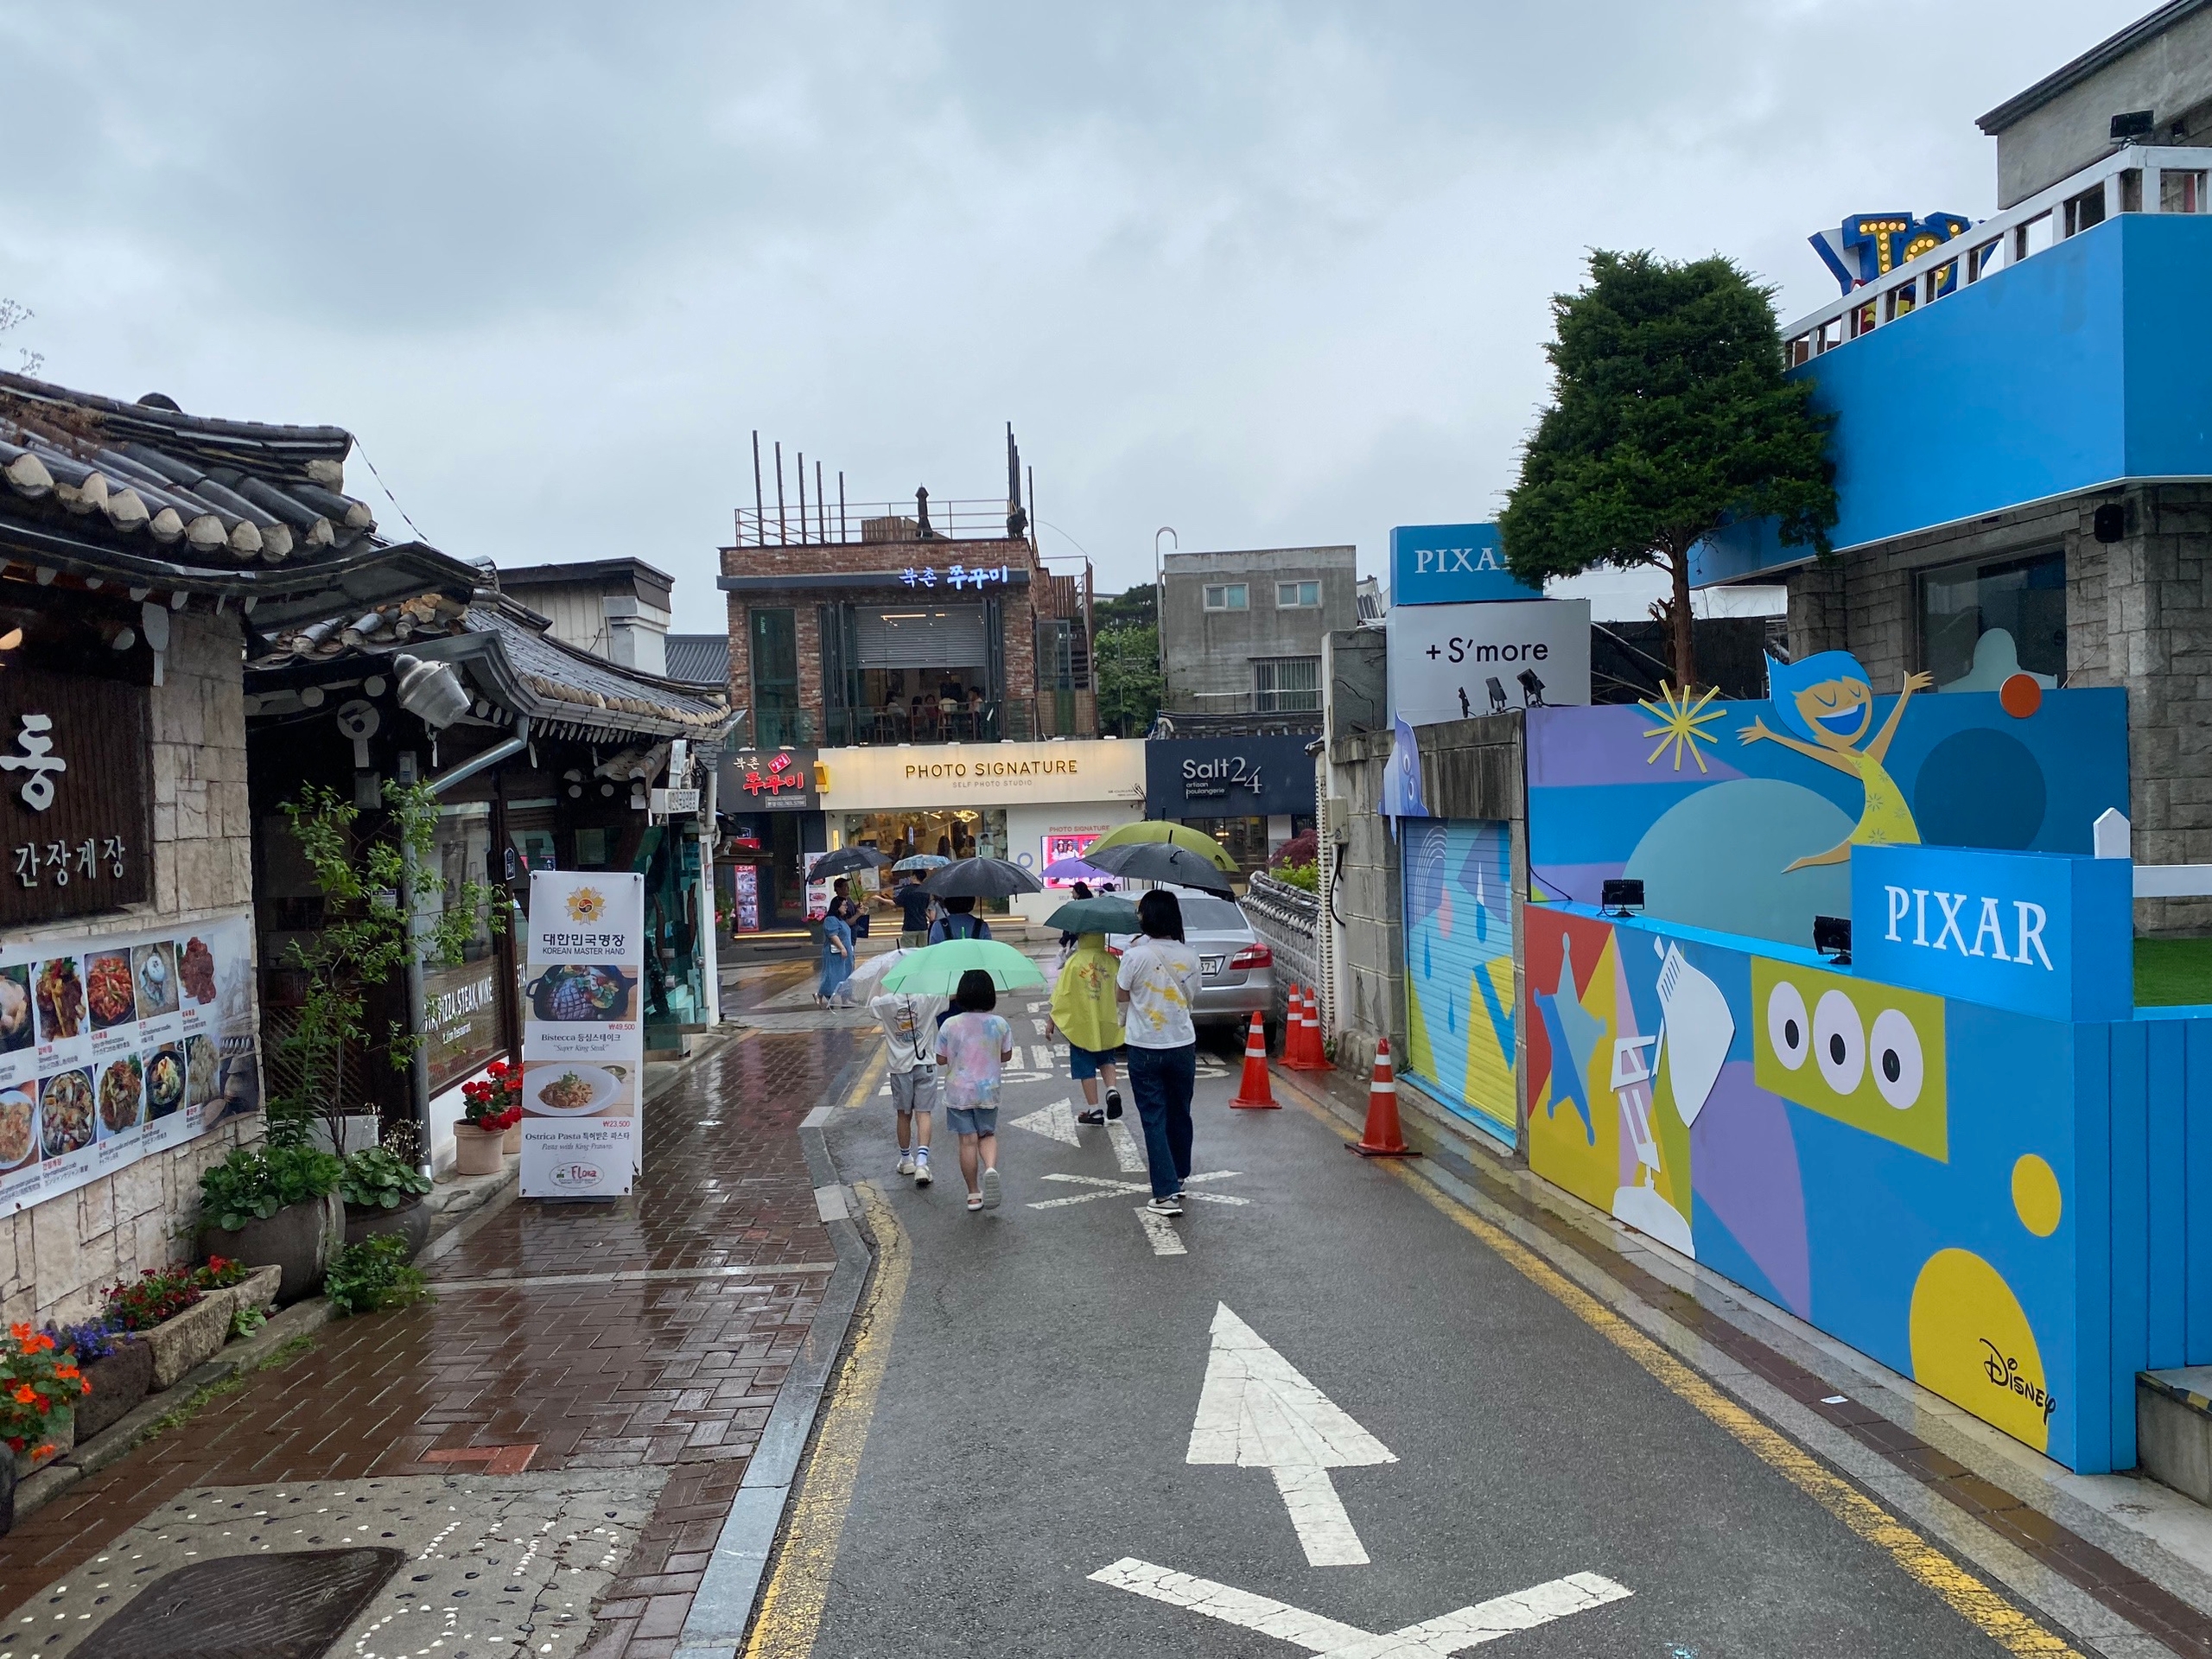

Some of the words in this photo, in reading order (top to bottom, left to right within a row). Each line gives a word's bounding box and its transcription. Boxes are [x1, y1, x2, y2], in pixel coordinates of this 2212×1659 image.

[899, 567, 938, 588] 북촌
[906, 764, 967, 779] PHOTO
[975, 760, 1077, 776] SIGNATURE
[16, 835, 126, 887] 간장게장
[1884, 885, 2054, 971] PIXAR
[543, 933, 626, 947] 대한민국명장
[578, 1033, 621, 1042] 등심스테이크
[525, 1132, 556, 1141] Ostrica
[557, 1132, 582, 1141] Pasta
